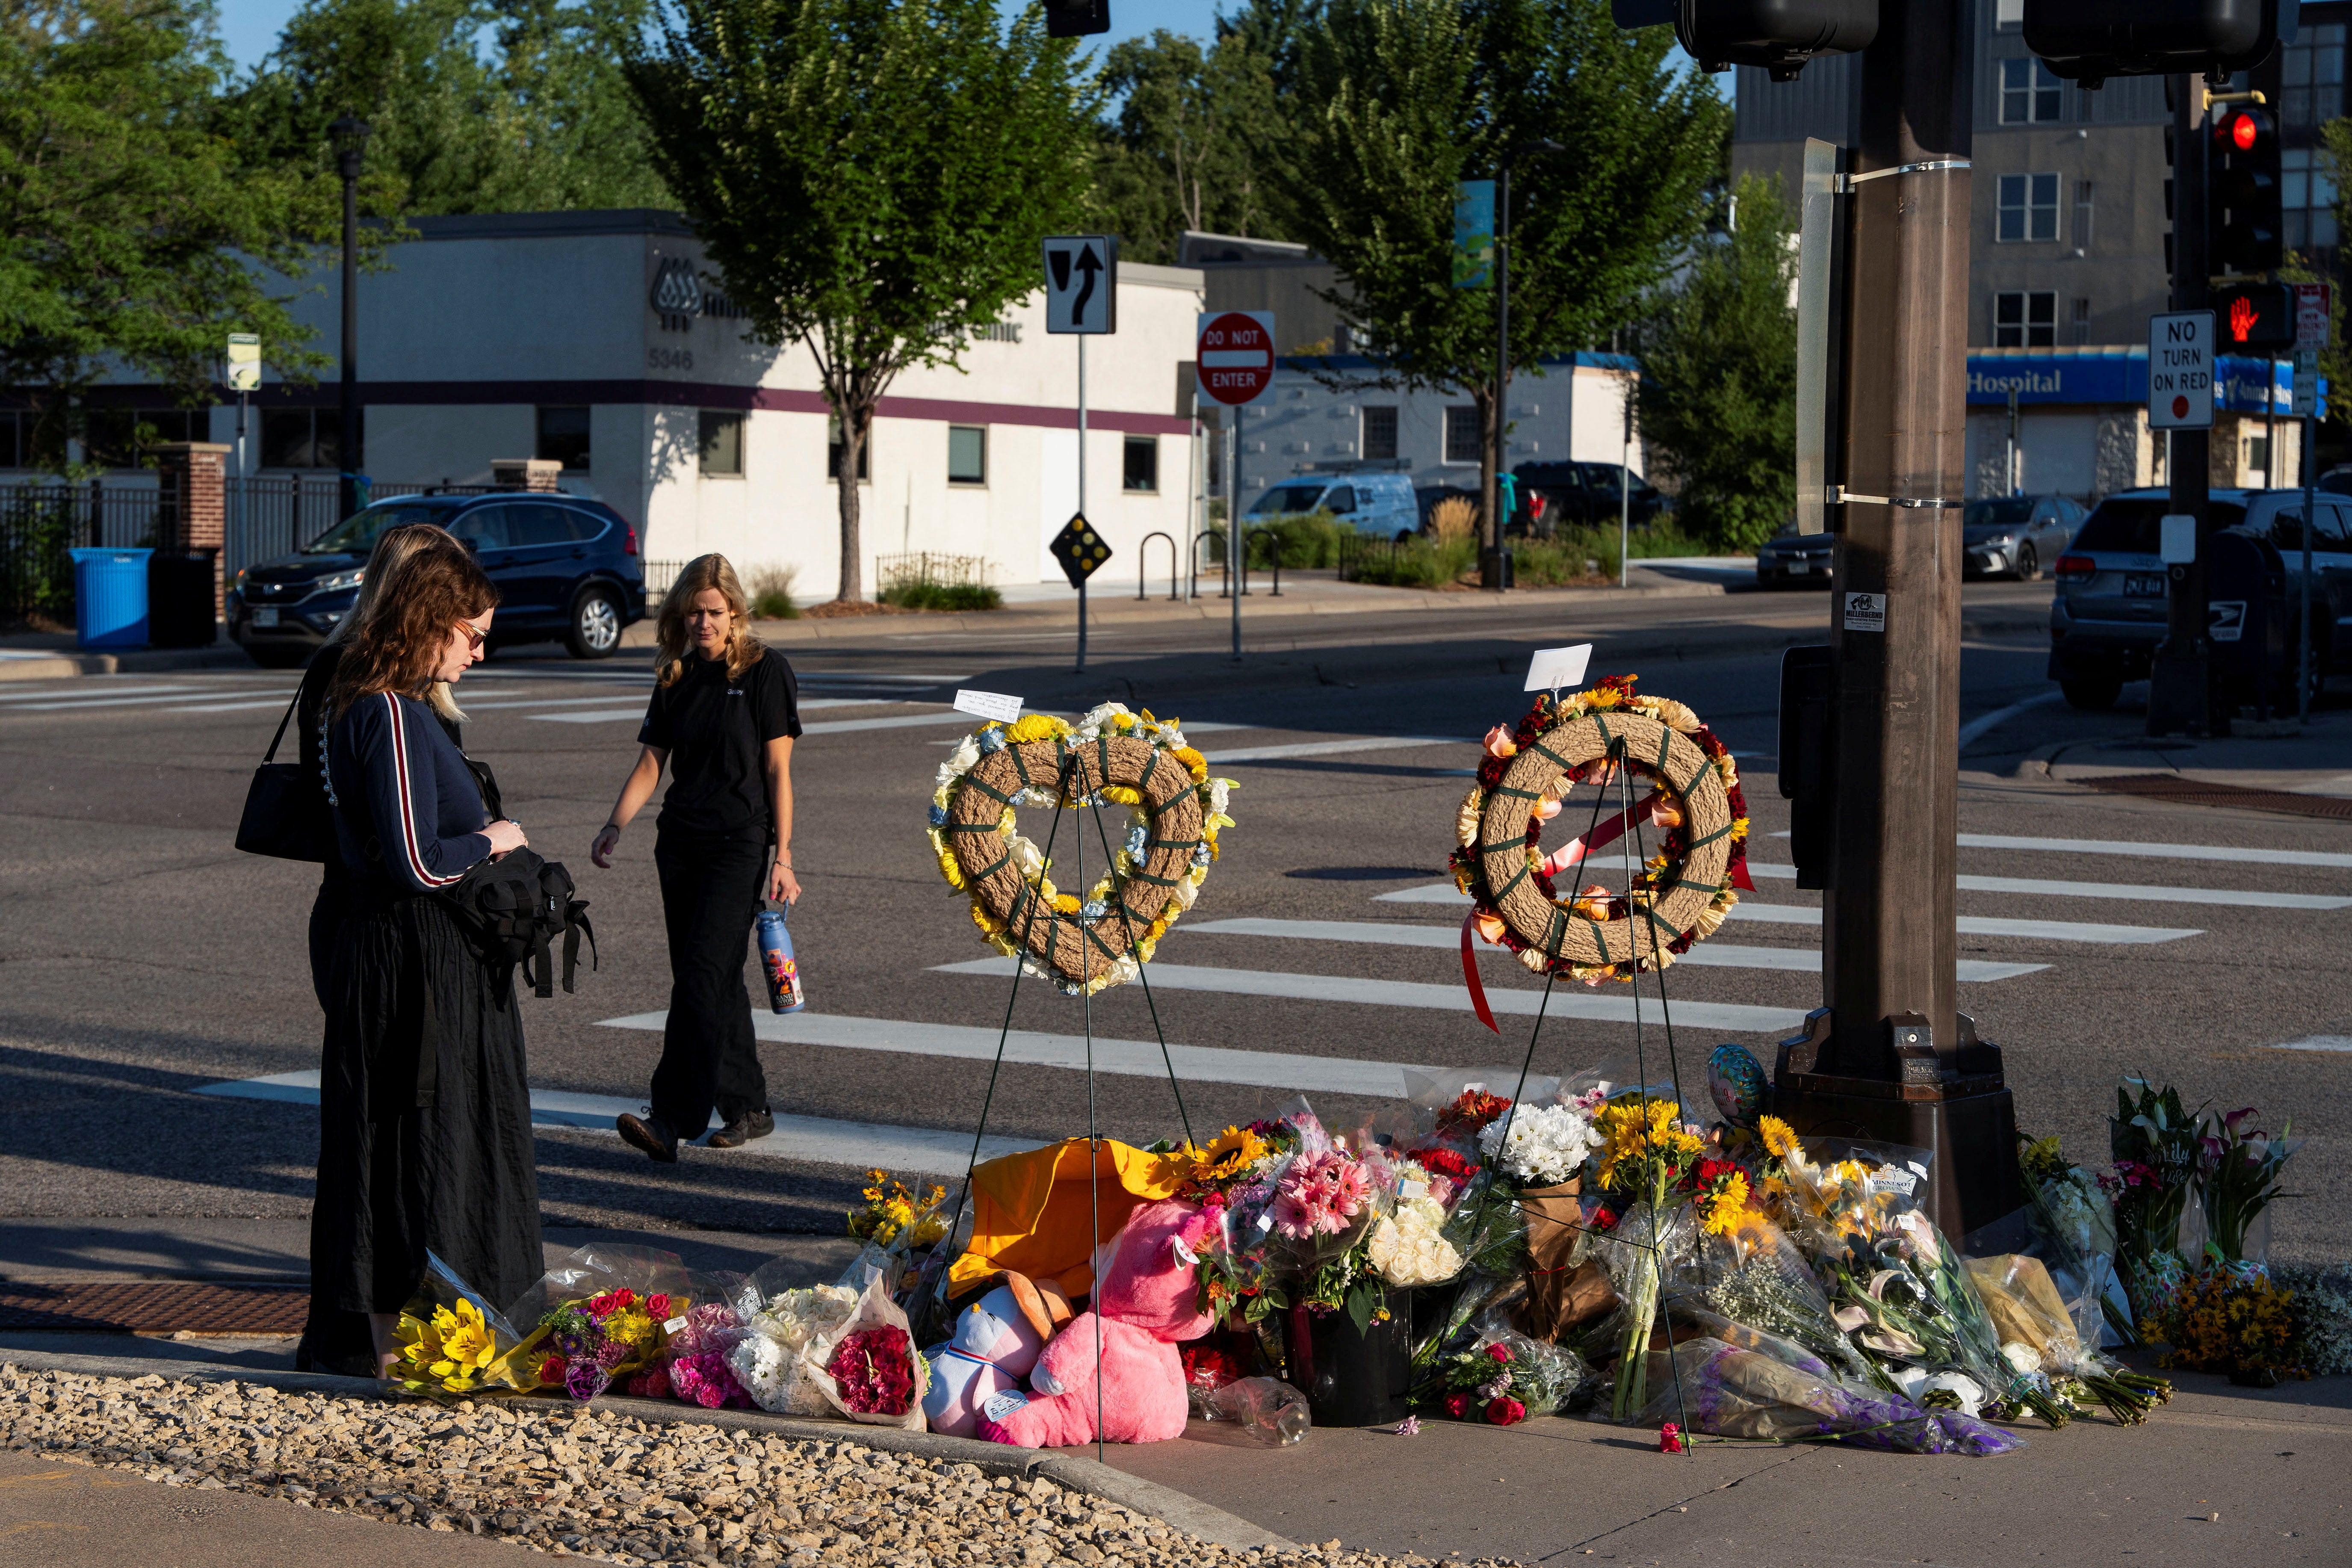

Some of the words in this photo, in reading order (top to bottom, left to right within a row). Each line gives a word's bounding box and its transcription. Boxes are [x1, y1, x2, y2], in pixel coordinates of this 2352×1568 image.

[1207, 331, 1224, 345] DO
[1232, 330, 1259, 345] NOT
[2168, 321, 2195, 342] NO
[2163, 348, 2201, 367] TURN
[1213, 372, 1256, 388] ENTER
[1966, 369, 2061, 394] Hospital
[2154, 375, 2174, 392] ON
[2180, 372, 2208, 391] RED
[1846, 610, 1883, 619] MILLERBERND
